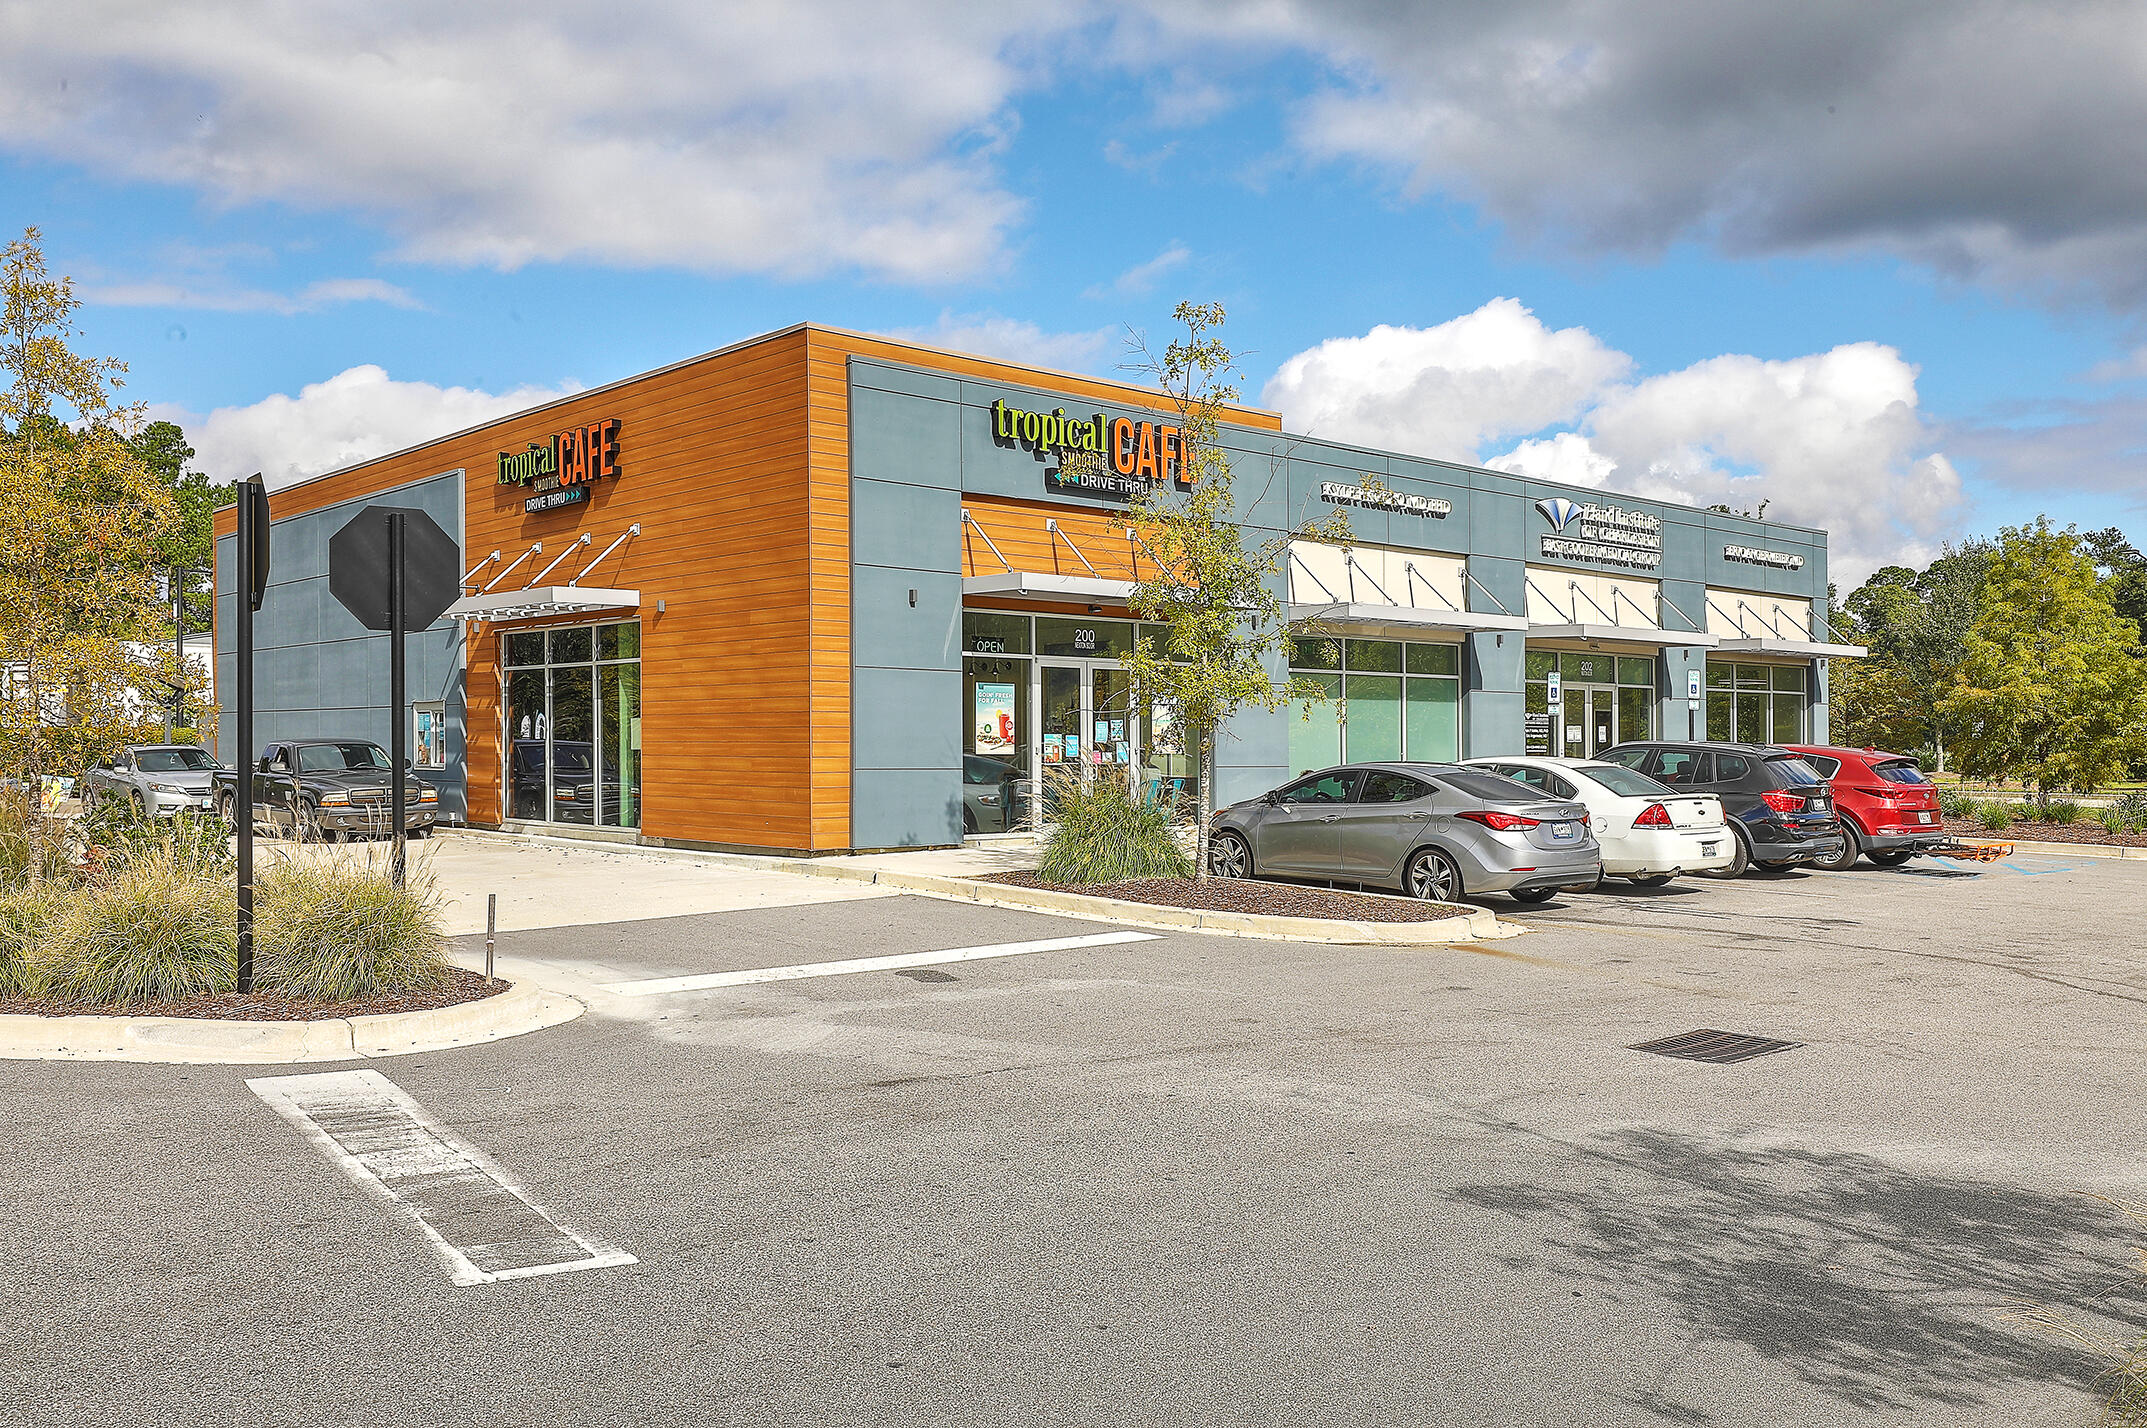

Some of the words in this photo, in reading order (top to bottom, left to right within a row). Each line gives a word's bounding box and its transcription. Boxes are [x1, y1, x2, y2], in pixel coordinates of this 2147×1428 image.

[996, 398, 1109, 453] tropical
[1113, 416, 1199, 484] CAFE
[497, 435, 556, 487] tropical
[558, 418, 615, 487] CAFE
[1061, 450, 1109, 471] SMOOTHIE
[1080, 474, 1116, 491] DRIVE
[1118, 479, 1148, 494] THRU
[526, 496, 546, 512] DRIVE
[546, 491, 566, 507] THRU
[1582, 502, 1615, 523] Hand
[976, 640, 1005, 653] OPEN
[1074, 629, 1096, 643] 200
[1581, 661, 1593, 671] 202
